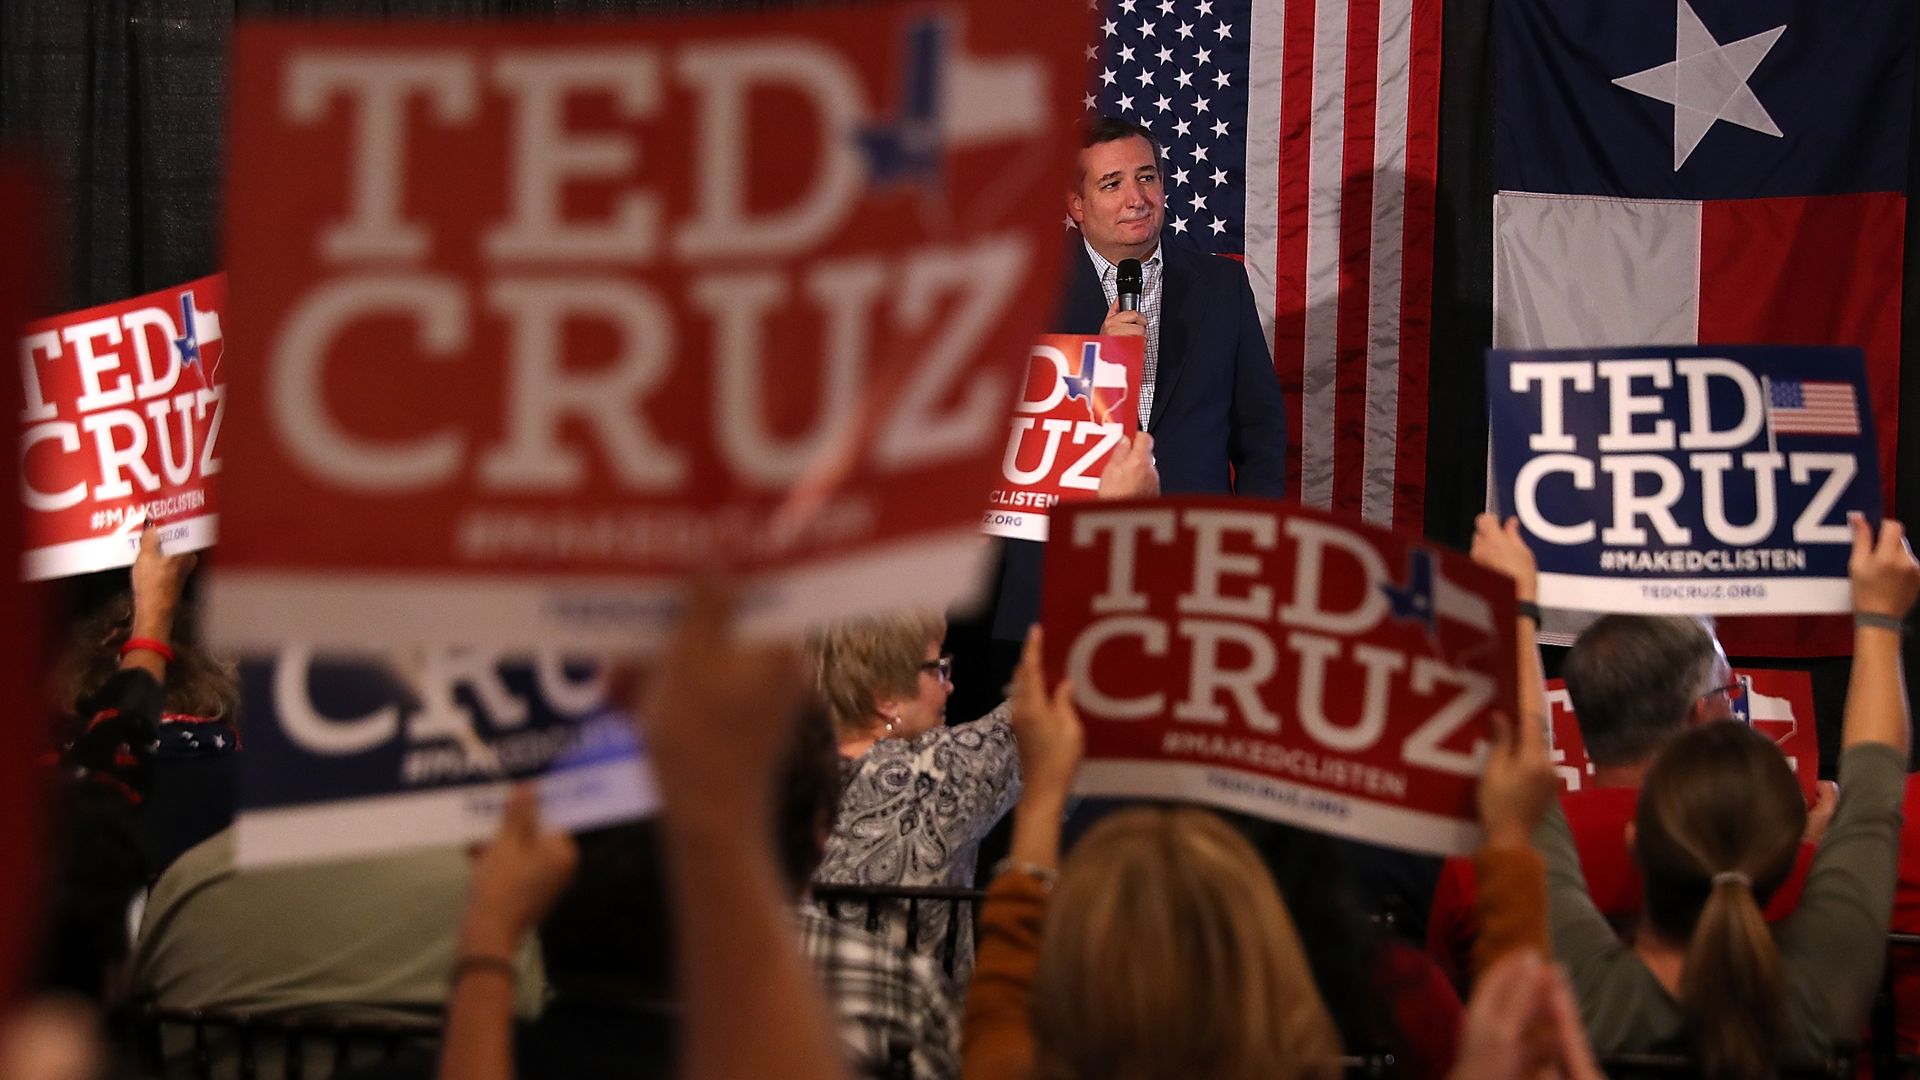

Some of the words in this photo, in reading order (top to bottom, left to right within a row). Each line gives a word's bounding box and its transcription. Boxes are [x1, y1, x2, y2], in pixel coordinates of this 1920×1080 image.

[280, 34, 868, 267] TED
[20, 305, 182, 422] TED
[267, 230, 1034, 497] CRUZ
[1509, 357, 1765, 452] TED
[20, 383, 227, 513] CRUZ
[1002, 417, 1124, 491] UZ
[1514, 452, 1866, 546] CRUZ
[1071, 507, 1392, 636] TED
[1600, 549, 1806, 571] #MAKEDCLISTEN
[1641, 583, 1768, 599] TEDCRUZ.ORG
[1065, 615, 1497, 778] CRUZ
[1162, 730, 1407, 797] #MAKEDCLISTEN
